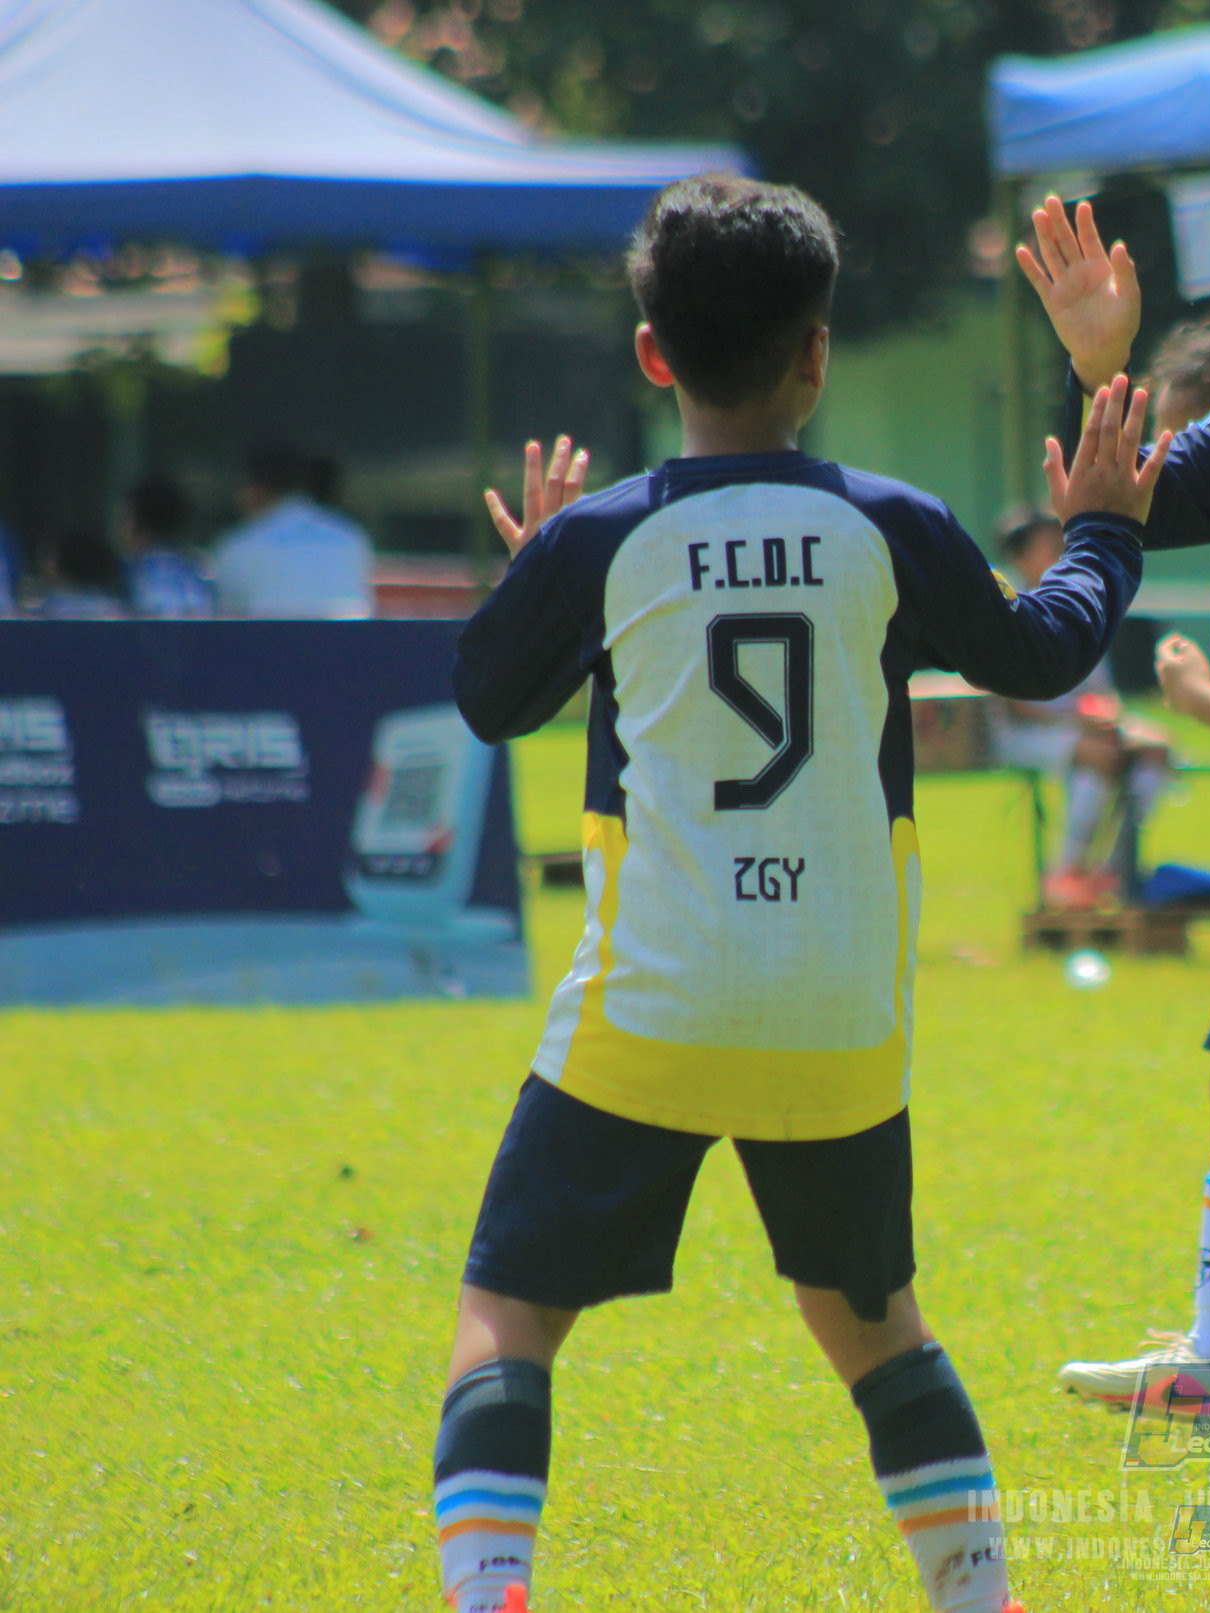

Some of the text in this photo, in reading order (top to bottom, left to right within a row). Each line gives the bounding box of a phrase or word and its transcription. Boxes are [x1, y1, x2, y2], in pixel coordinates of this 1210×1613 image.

[688, 536, 824, 591] F.C.D.C
[706, 612, 814, 811] 9
[734, 857, 805, 901] ZGY
